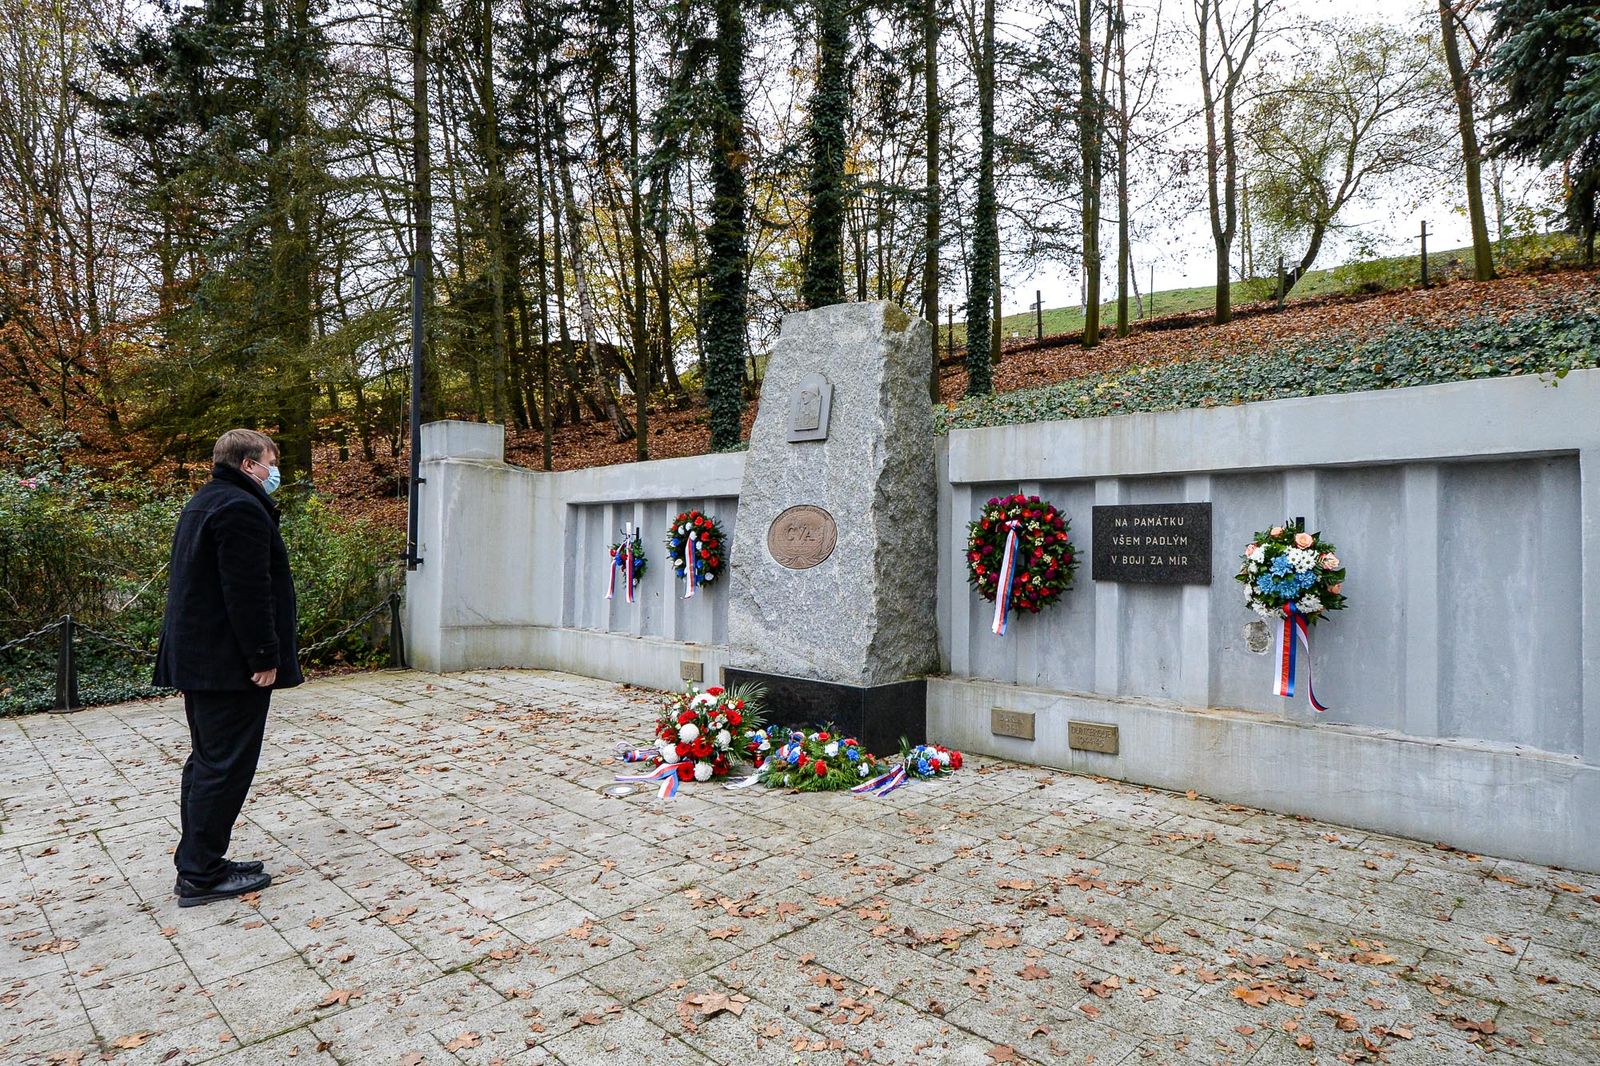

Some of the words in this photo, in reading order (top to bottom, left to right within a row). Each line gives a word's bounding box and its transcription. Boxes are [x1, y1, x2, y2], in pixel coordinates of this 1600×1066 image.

[1115, 518, 1128, 527] NA
[1134, 515, 1184, 527] PAMÁTKU
[1112, 534, 1140, 546] VŠEM
[1145, 534, 1188, 546] PADLÝM
[1111, 555, 1117, 564] V
[1122, 555, 1145, 565] BOJI
[1150, 555, 1163, 565] ZA
